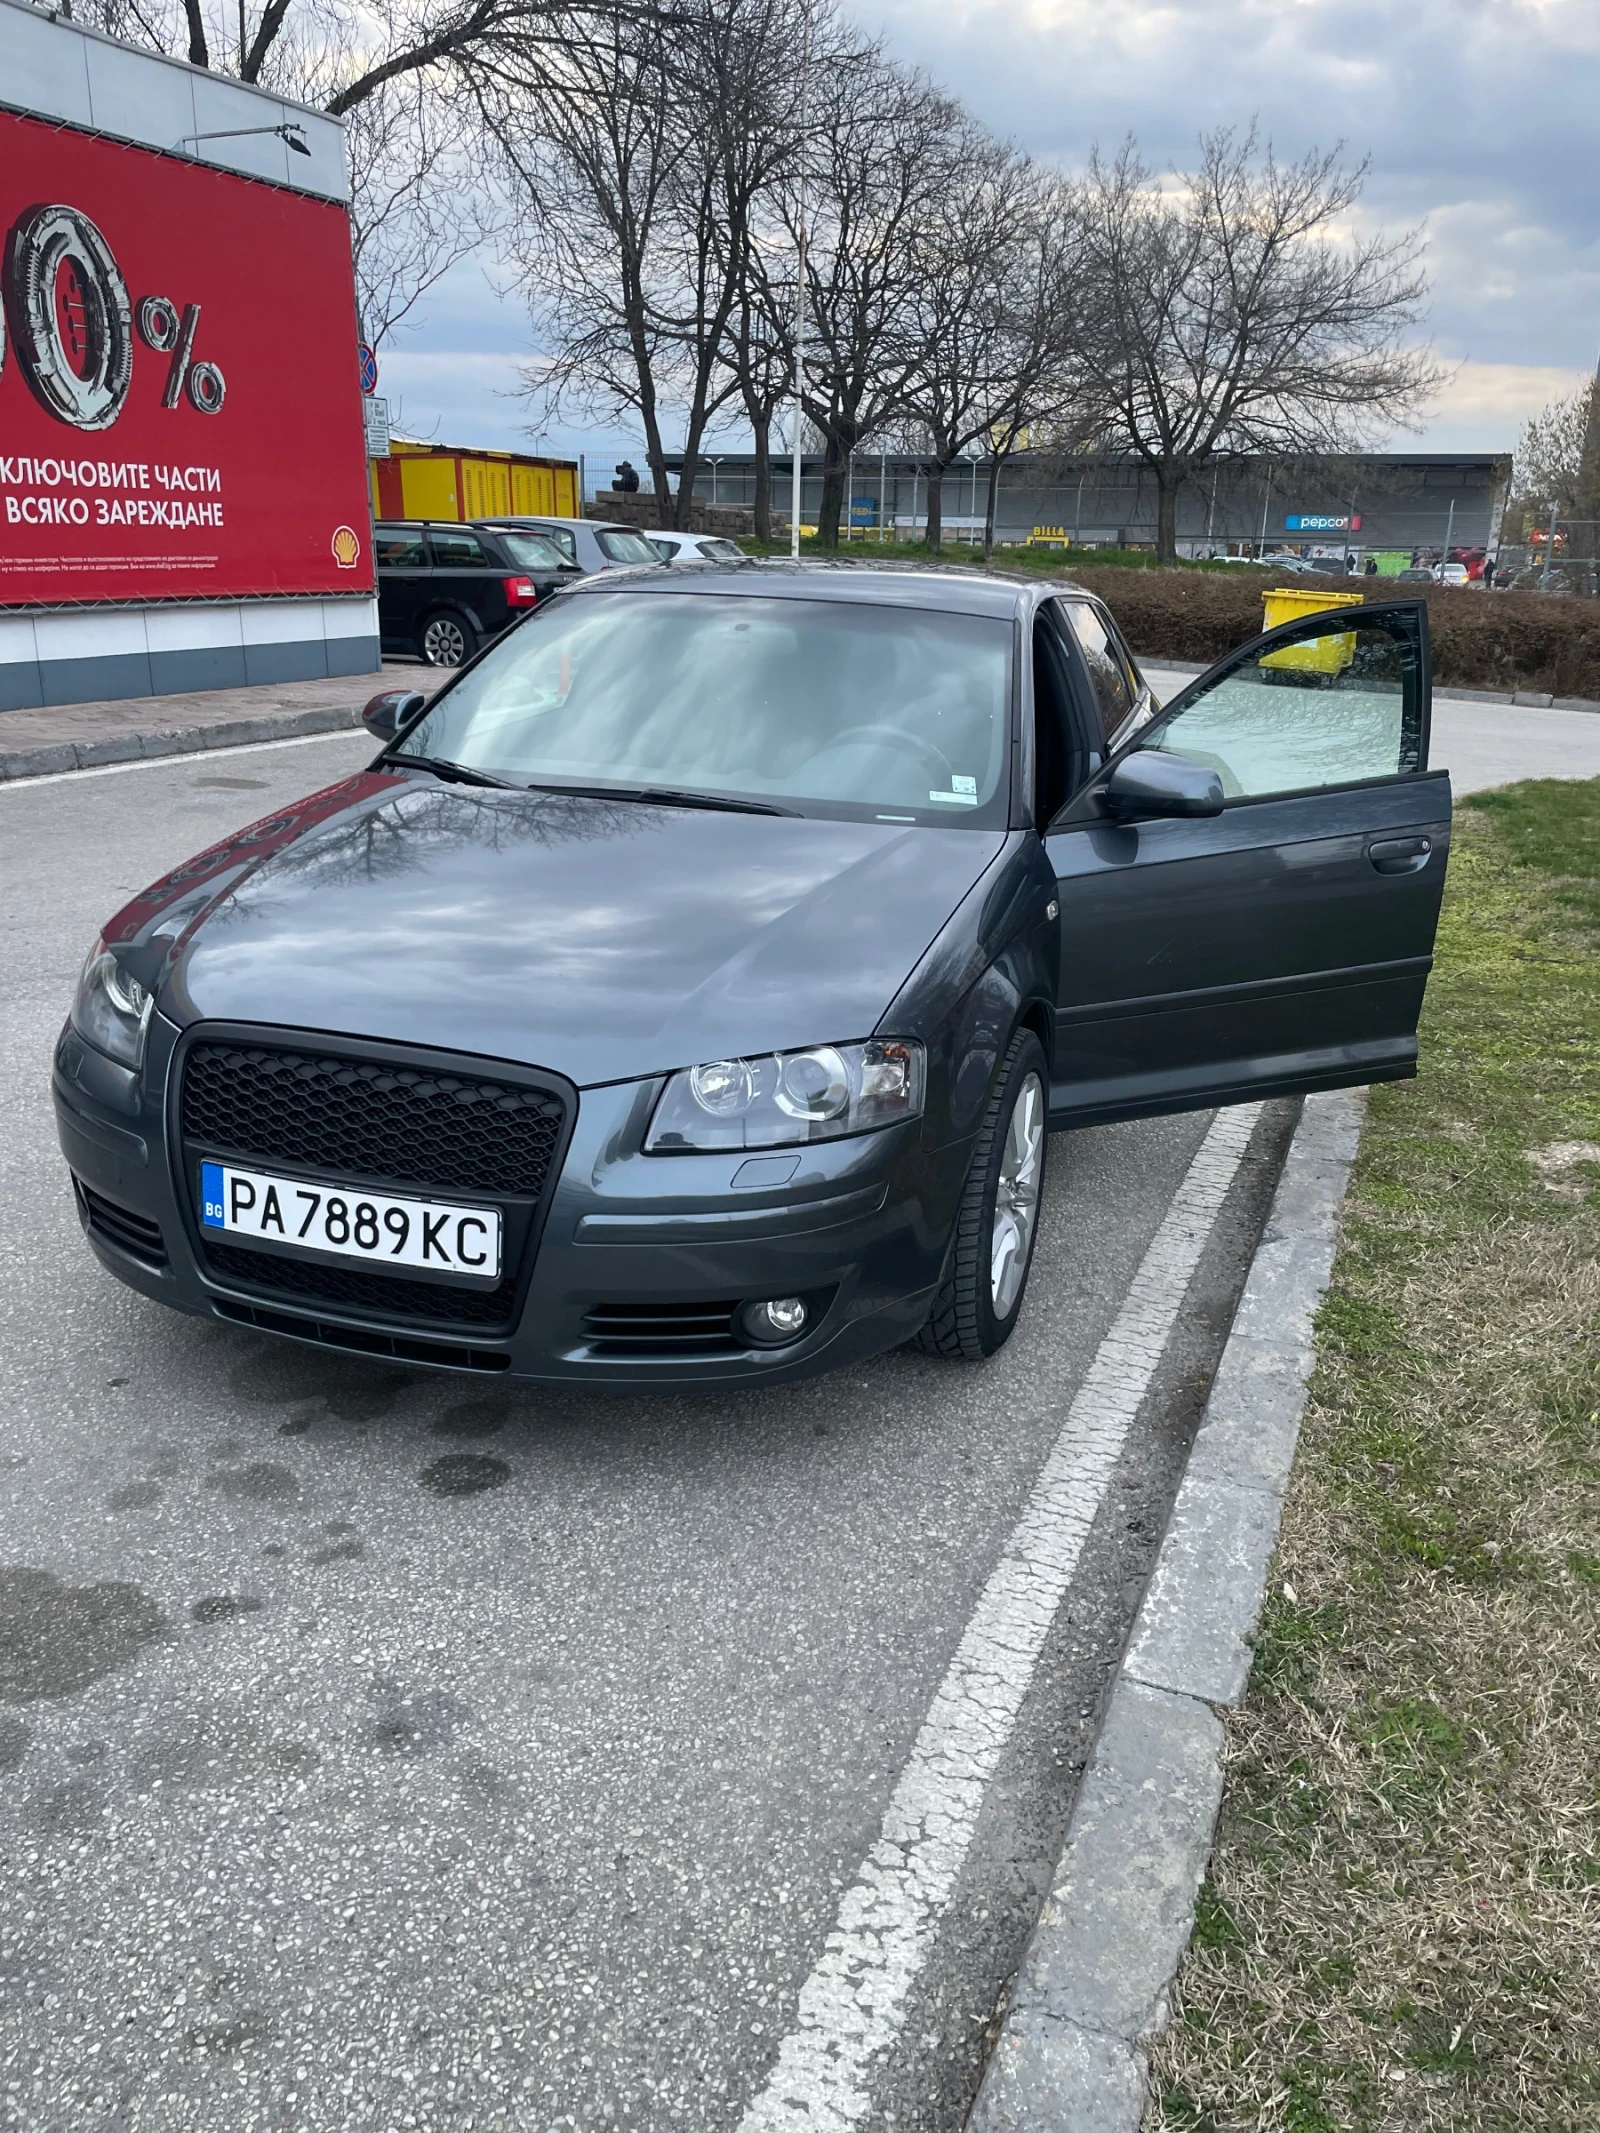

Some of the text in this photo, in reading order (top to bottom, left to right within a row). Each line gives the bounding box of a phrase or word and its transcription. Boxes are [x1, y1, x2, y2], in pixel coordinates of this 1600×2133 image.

[0, 203, 227, 432] 0%
[0, 456, 222, 492] КЛЮЧОВИТЕ ЧАСТИ
[6, 496, 225, 529] ВСЯКО ЗАРЕЖДАНЕ
[1301, 517, 1344, 529] pepco
[1033, 526, 1065, 536] BILLA
[205, 1202, 223, 1219] BG
